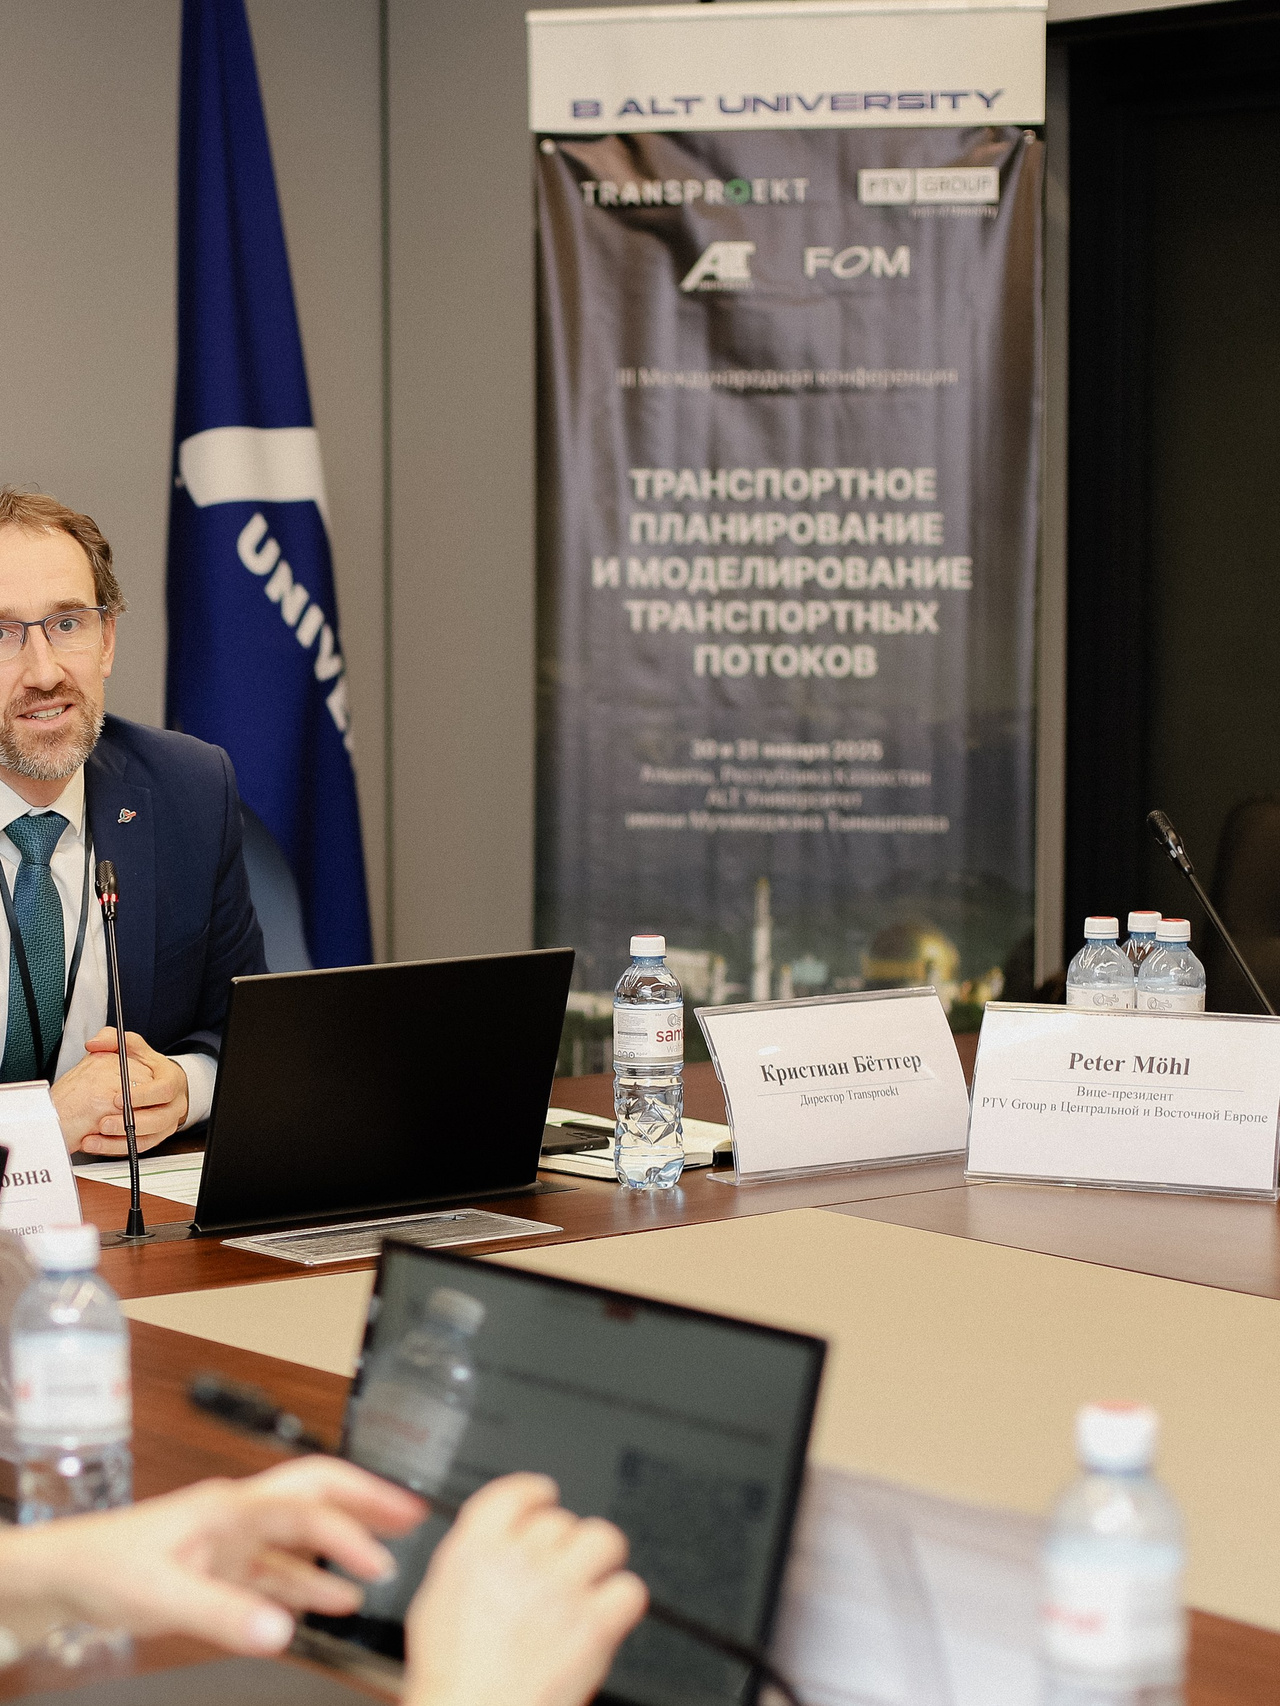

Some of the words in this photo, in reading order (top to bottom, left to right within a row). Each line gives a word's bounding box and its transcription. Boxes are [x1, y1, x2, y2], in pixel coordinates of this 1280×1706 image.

[618, 97, 703, 116] ALT
[719, 88, 1004, 114] UNIVERSITY
[804, 246, 910, 279] FOM
[630, 467, 937, 501] ТРАНСПОРТНОЕ
[630, 512, 943, 545] ПЛАНИРОВАНИЕ
[592, 557, 619, 590] И
[627, 557, 972, 594] МОДЕЛИРОВАНИЕ
[624, 600, 939, 634] ТРАНСПОРТНЫХ
[694, 645, 878, 678] ПОТОКОВ
[760, 1061, 850, 1086] Кристиан
[852, 1053, 922, 1073] Бёттгер
[1067, 1052, 1126, 1073] Peter
[1132, 1055, 1191, 1076] Möhl
[800, 1092, 845, 1107] Директор
[846, 1085, 900, 1102] Transproekt
[981, 1096, 1008, 1109] PTV
[1011, 1098, 1047, 1114] Group
[1060, 1101, 1140, 1118] Центральной
[1154, 1105, 1220, 1121] Восточной
[1223, 1109, 1269, 1125] Европе
[1076, 1085, 1174, 1103] Вице-президент
